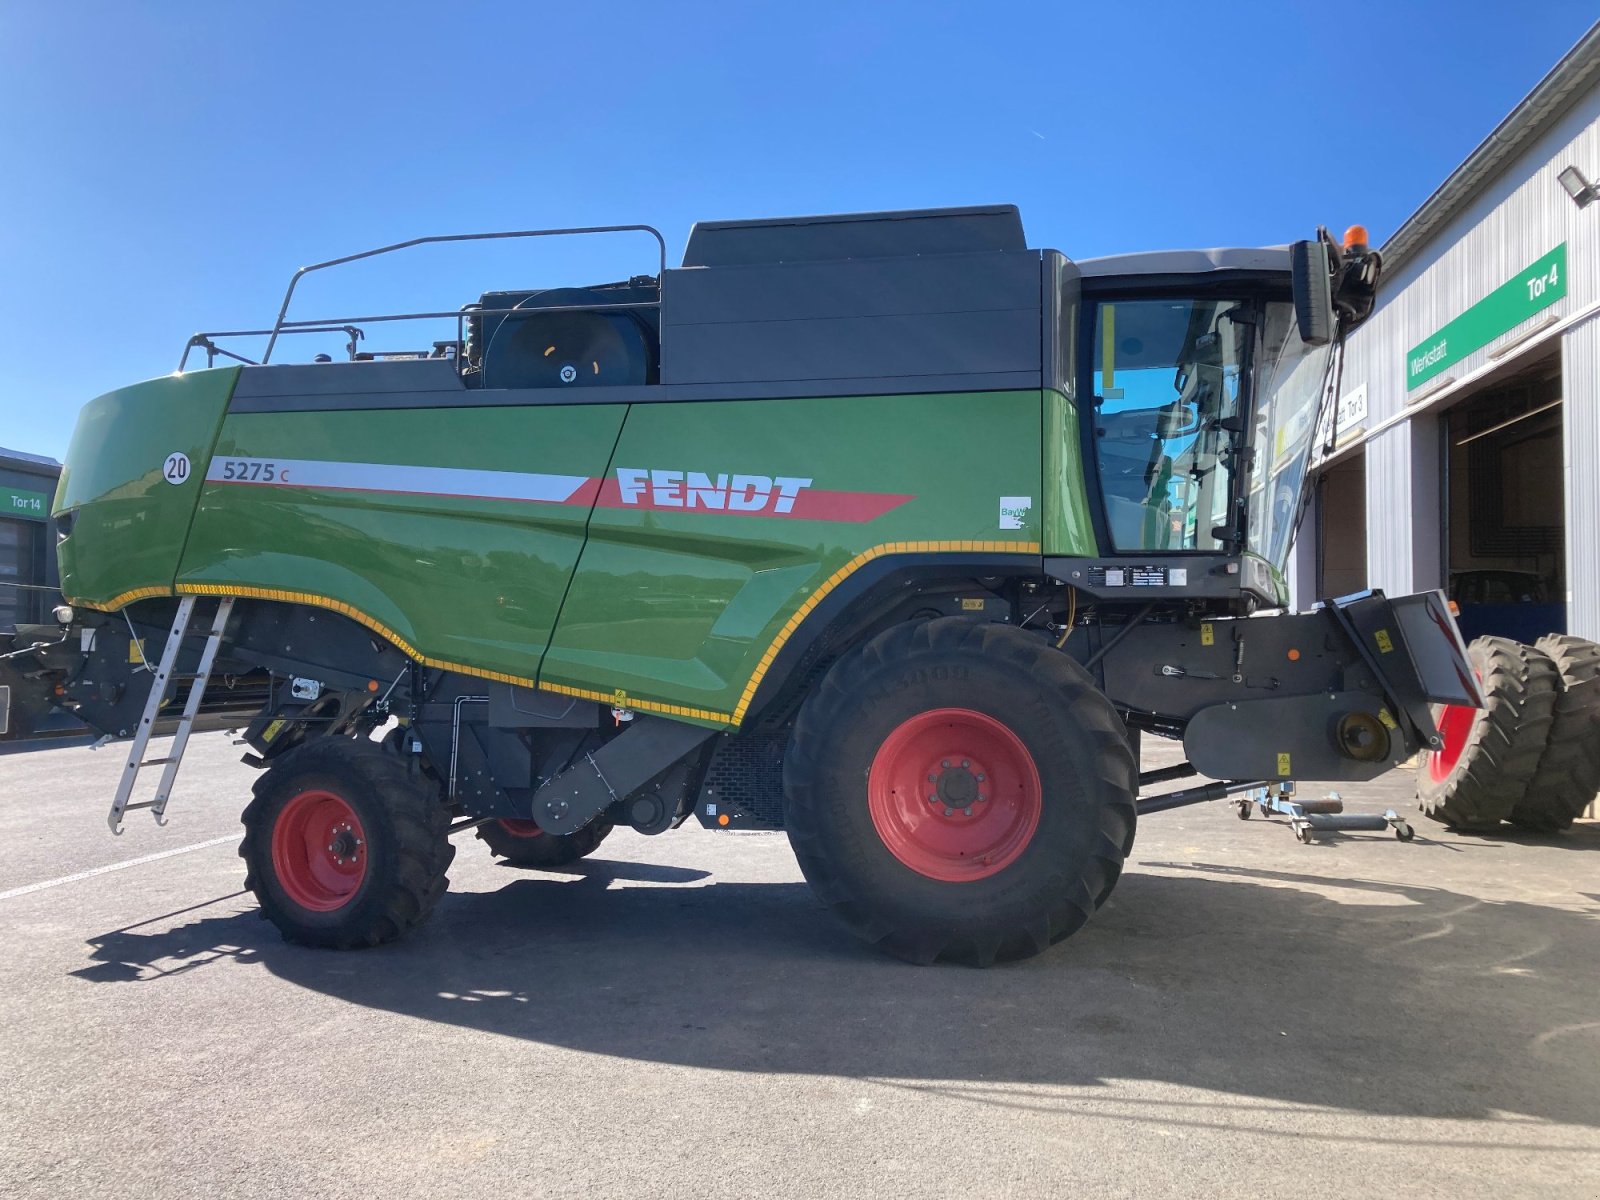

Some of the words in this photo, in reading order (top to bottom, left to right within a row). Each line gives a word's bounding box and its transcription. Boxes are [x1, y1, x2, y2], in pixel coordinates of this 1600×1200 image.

[1411, 339, 1447, 377] Werkstatt
[1527, 274, 1548, 300] Tor
[1549, 263, 1558, 285] 4
[1348, 400, 1358, 417] Tor
[1358, 394, 1363, 412] 3
[167, 457, 187, 479] 20
[223, 461, 275, 482] 5275
[616, 467, 813, 514] FENDT
[11, 495, 29, 508] Tor
[30, 498, 40, 510] 14
